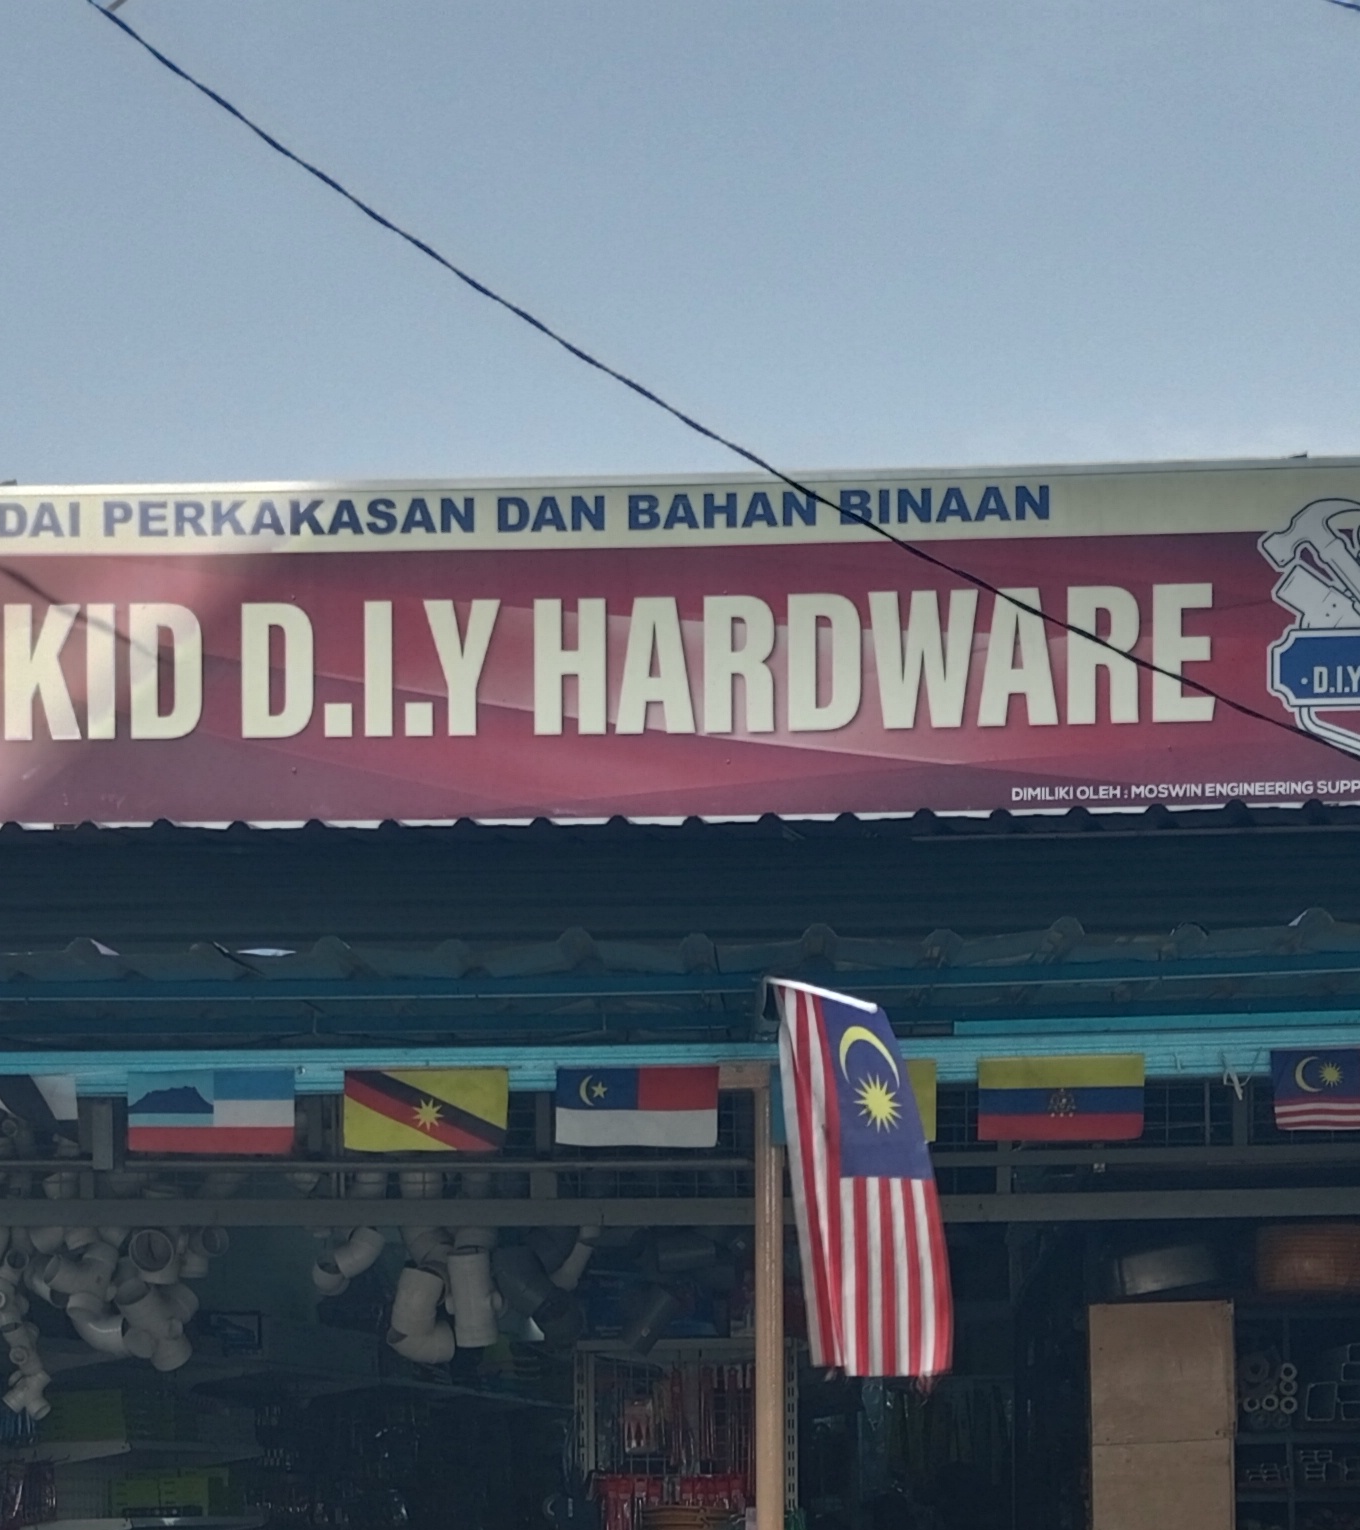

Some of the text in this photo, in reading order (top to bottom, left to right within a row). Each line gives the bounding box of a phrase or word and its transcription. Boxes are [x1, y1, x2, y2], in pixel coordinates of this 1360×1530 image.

[103, 497, 476, 537] PERKAKASAN
[497, 495, 606, 533] DAN
[627, 490, 818, 532] BAHAN
[839, 485, 1051, 527] BINAAN
[241, 599, 502, 738] D.I.Y
[532, 582, 1218, 736] HARDWARE
[1011, 786, 1074, 801] DIMILIKI
[1076, 785, 1121, 800] OLEH
[1131, 783, 1202, 799] MOSWIN
[1205, 780, 1313, 797] ENGINEERING
